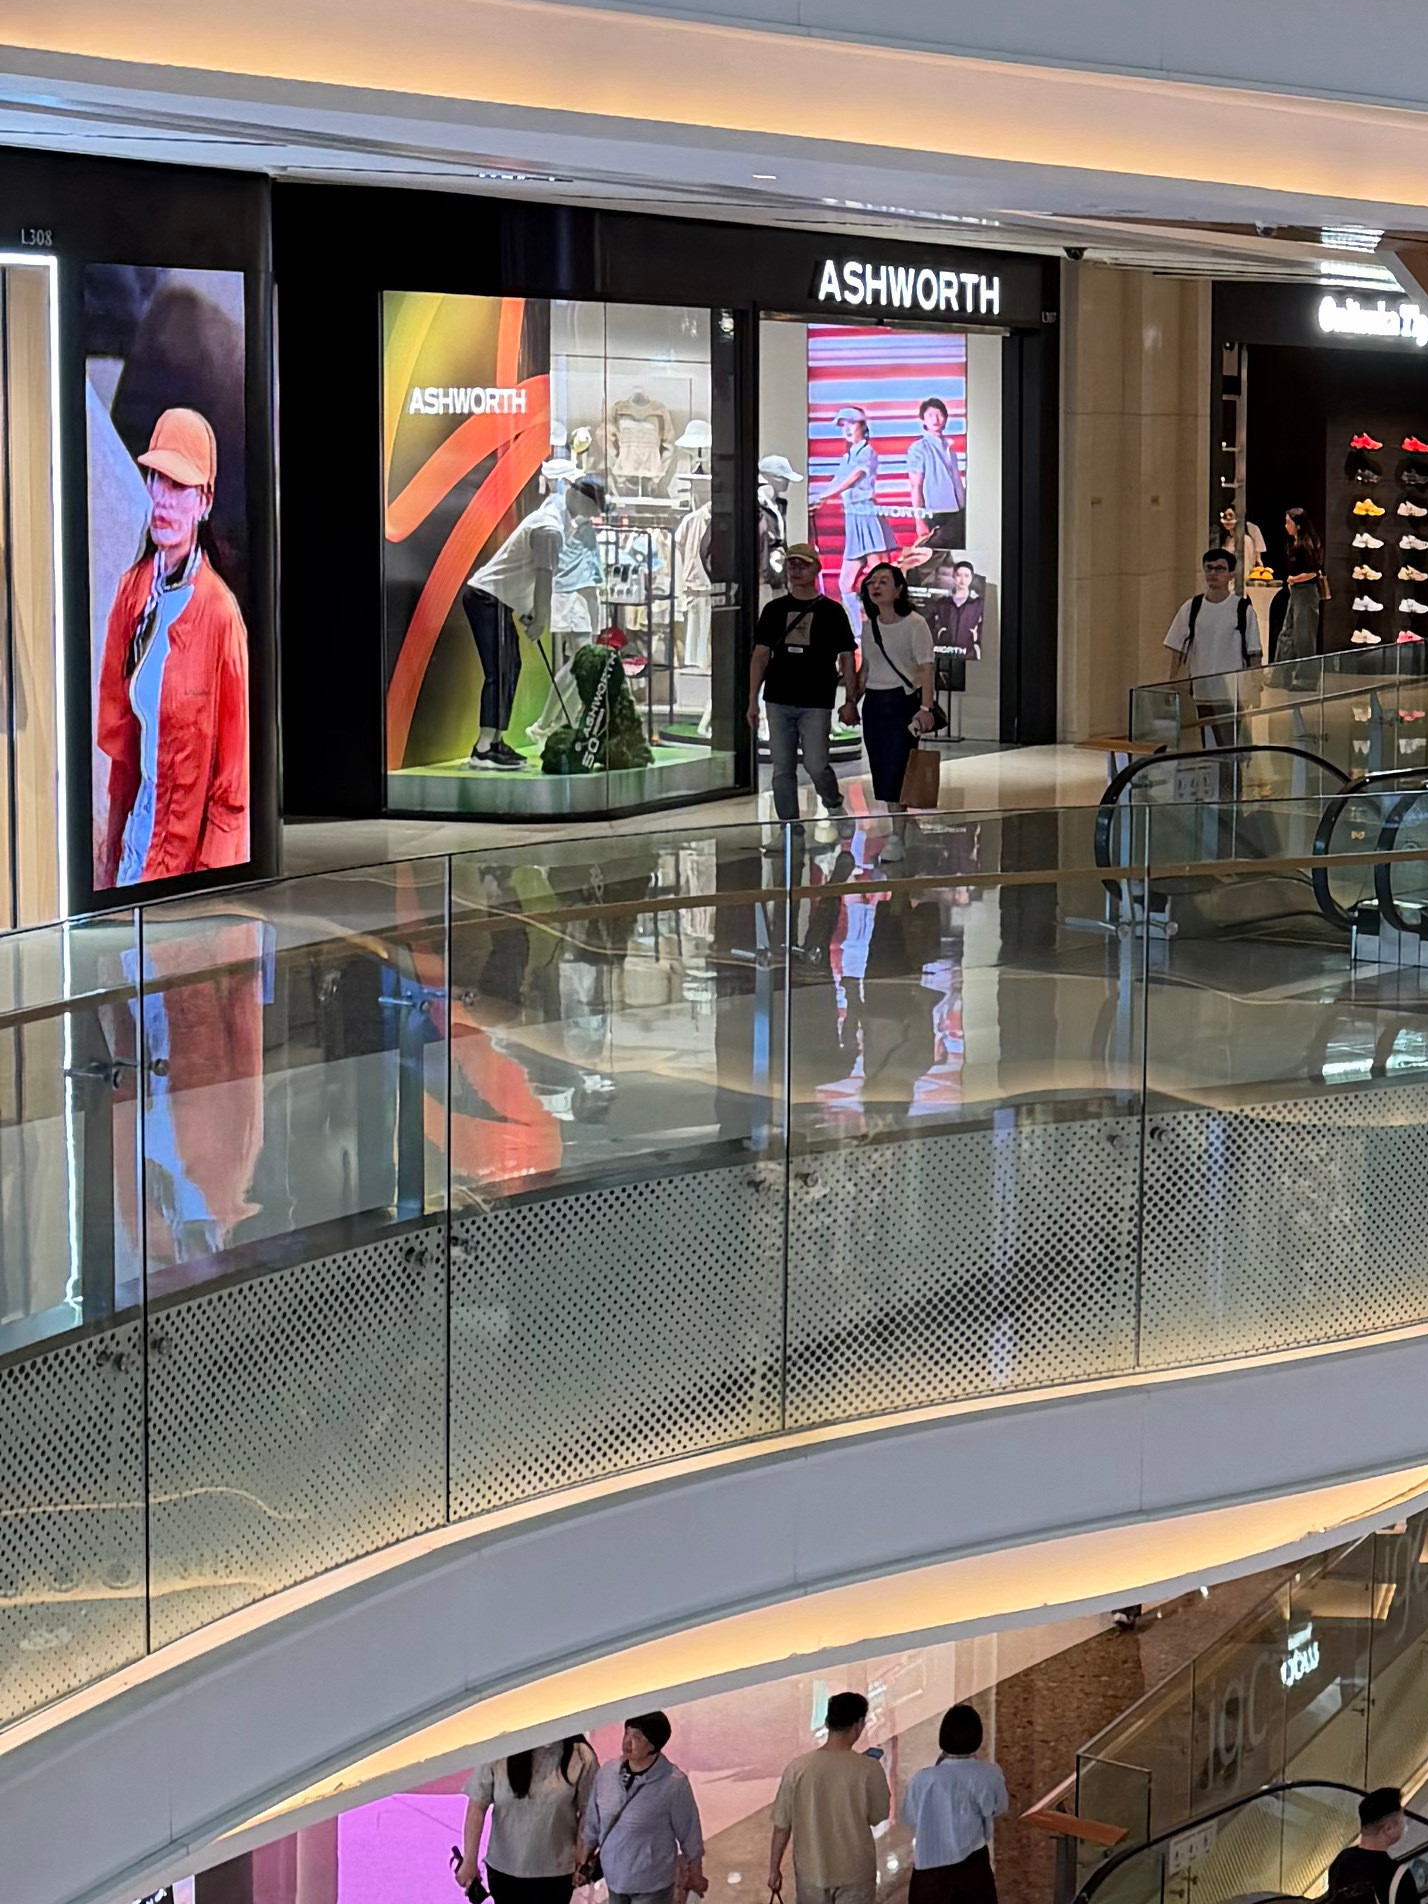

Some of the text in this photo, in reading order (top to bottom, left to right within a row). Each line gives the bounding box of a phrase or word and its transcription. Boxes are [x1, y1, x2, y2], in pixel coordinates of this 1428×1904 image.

[21, 228, 53, 247] L308
[818, 259, 1000, 315] ASHWORTH
[409, 386, 527, 415] ASHWORTH
